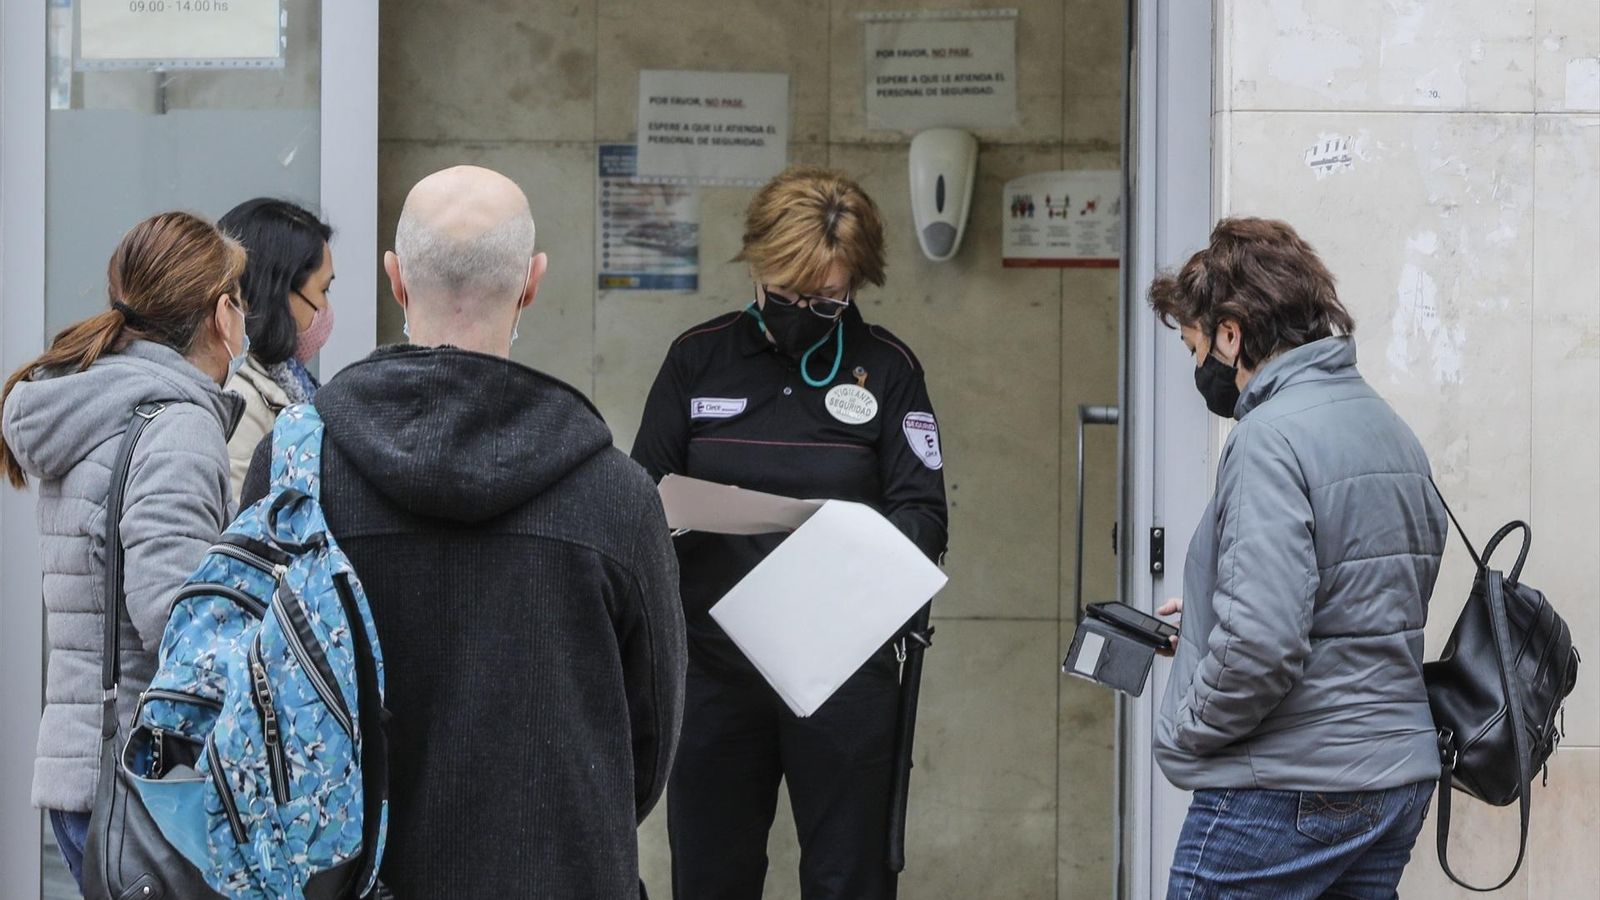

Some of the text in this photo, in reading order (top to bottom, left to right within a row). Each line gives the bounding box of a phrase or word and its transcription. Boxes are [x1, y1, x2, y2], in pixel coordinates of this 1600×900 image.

[129, 0, 165, 12] 09.00
[175, 0, 210, 12] 14.00
[213, 0, 229, 12] hs
[876, 49, 895, 58] POR
[931, 48, 947, 58] NO
[876, 75, 909, 85] ESPERE
[920, 74, 940, 84] QUE
[942, 73, 952, 83] LE
[954, 73, 993, 82] ATIENDA
[995, 72, 1005, 82] EL
[876, 87, 924, 97] PERSONAL
[926, 87, 938, 97] DE
[649, 96, 668, 105] POR
[705, 98, 720, 108] NO
[649, 122, 681, 132] ESPERE
[691, 123, 712, 133] QUE
[713, 124, 723, 133] LE
[725, 124, 764, 135] ATIENDA
[766, 125, 777, 135] EL
[649, 135, 695, 145] PERSONAL
[697, 136, 709, 146] DE
[833, 387, 873, 407] VIGILANTE
[829, 397, 872, 417] SEGURIDAD
